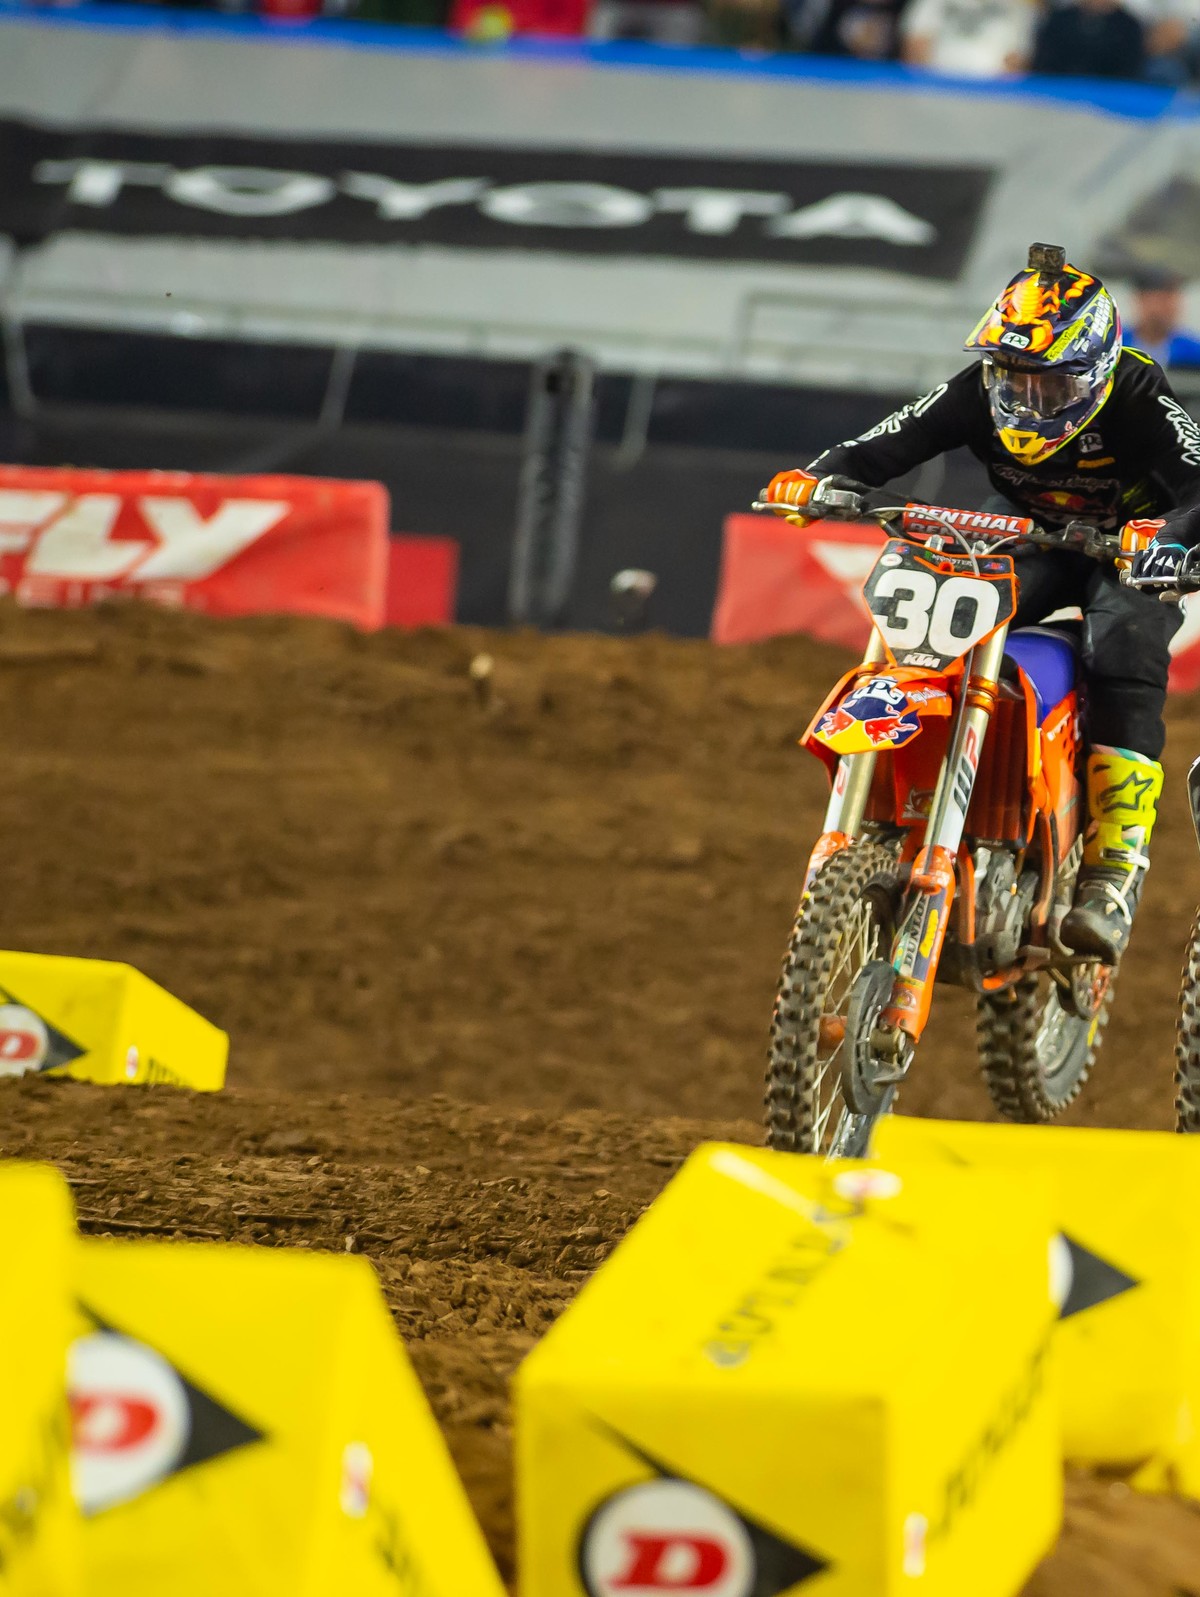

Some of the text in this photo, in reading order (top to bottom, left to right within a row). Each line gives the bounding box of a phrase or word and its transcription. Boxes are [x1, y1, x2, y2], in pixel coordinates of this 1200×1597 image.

[33, 157, 937, 246] TOYOTA
[907, 505, 1020, 533] RENTHAL
[873, 568, 1000, 658] 30
[903, 652, 941, 669] KTM
[608, 1529, 733, 1590] D
